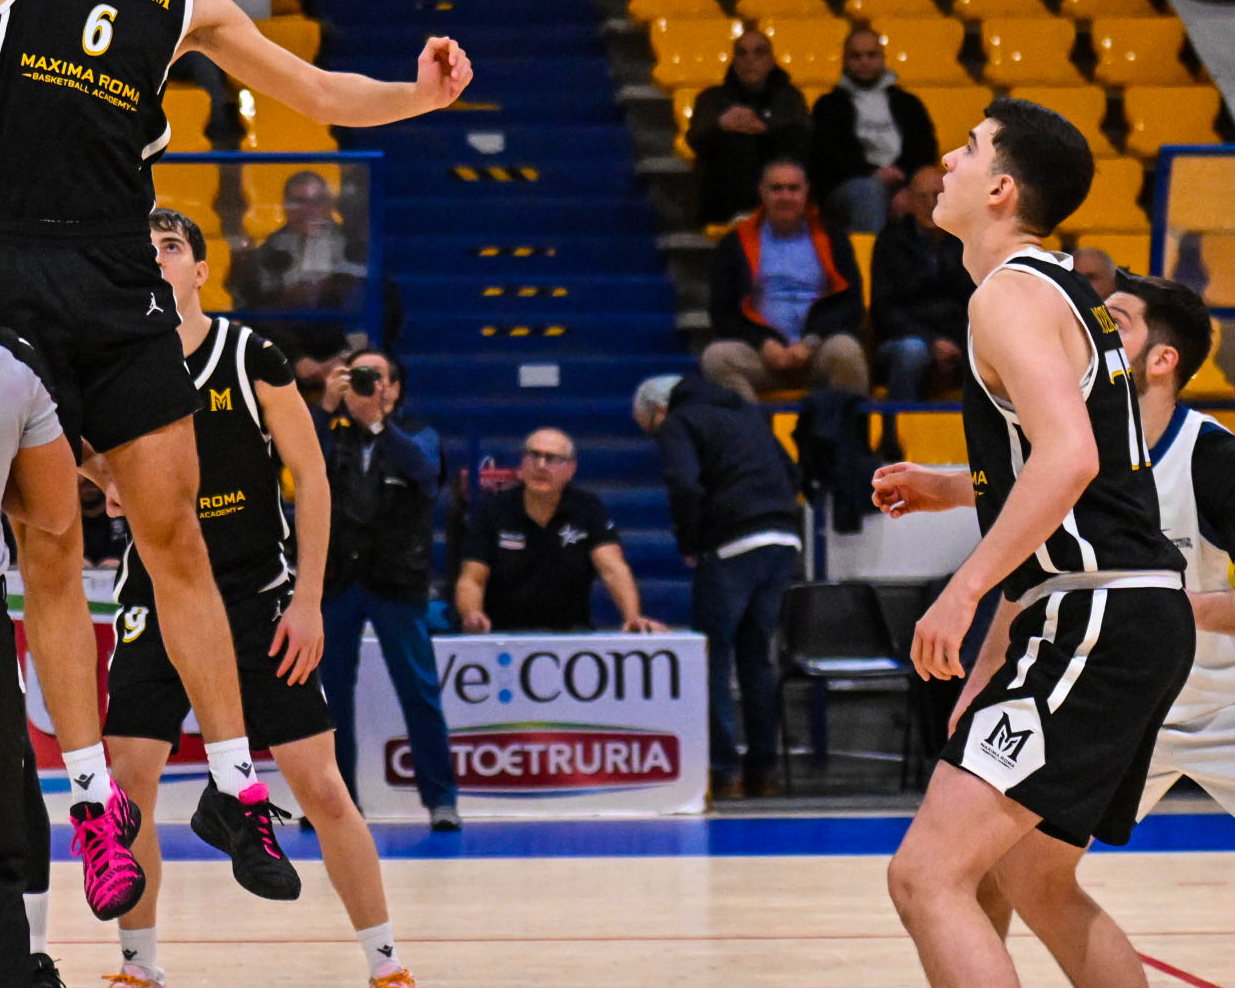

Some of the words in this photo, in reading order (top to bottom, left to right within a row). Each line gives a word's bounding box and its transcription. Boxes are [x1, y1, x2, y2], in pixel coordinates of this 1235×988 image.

[82, 3, 118, 57] 6
[21, 53, 94, 83] MAXIMA
[98, 73, 140, 105] ROMA
[32, 72, 90, 94] BASKETBALL
[92, 89, 132, 111] ACADEMY
[199, 506, 238, 520] ACADEMY
[200, 490, 246, 510] ROMA
[122, 606, 149, 644] 9
[440, 649, 681, 704] e:com
[391, 741, 671, 778] OTOETRURIA
